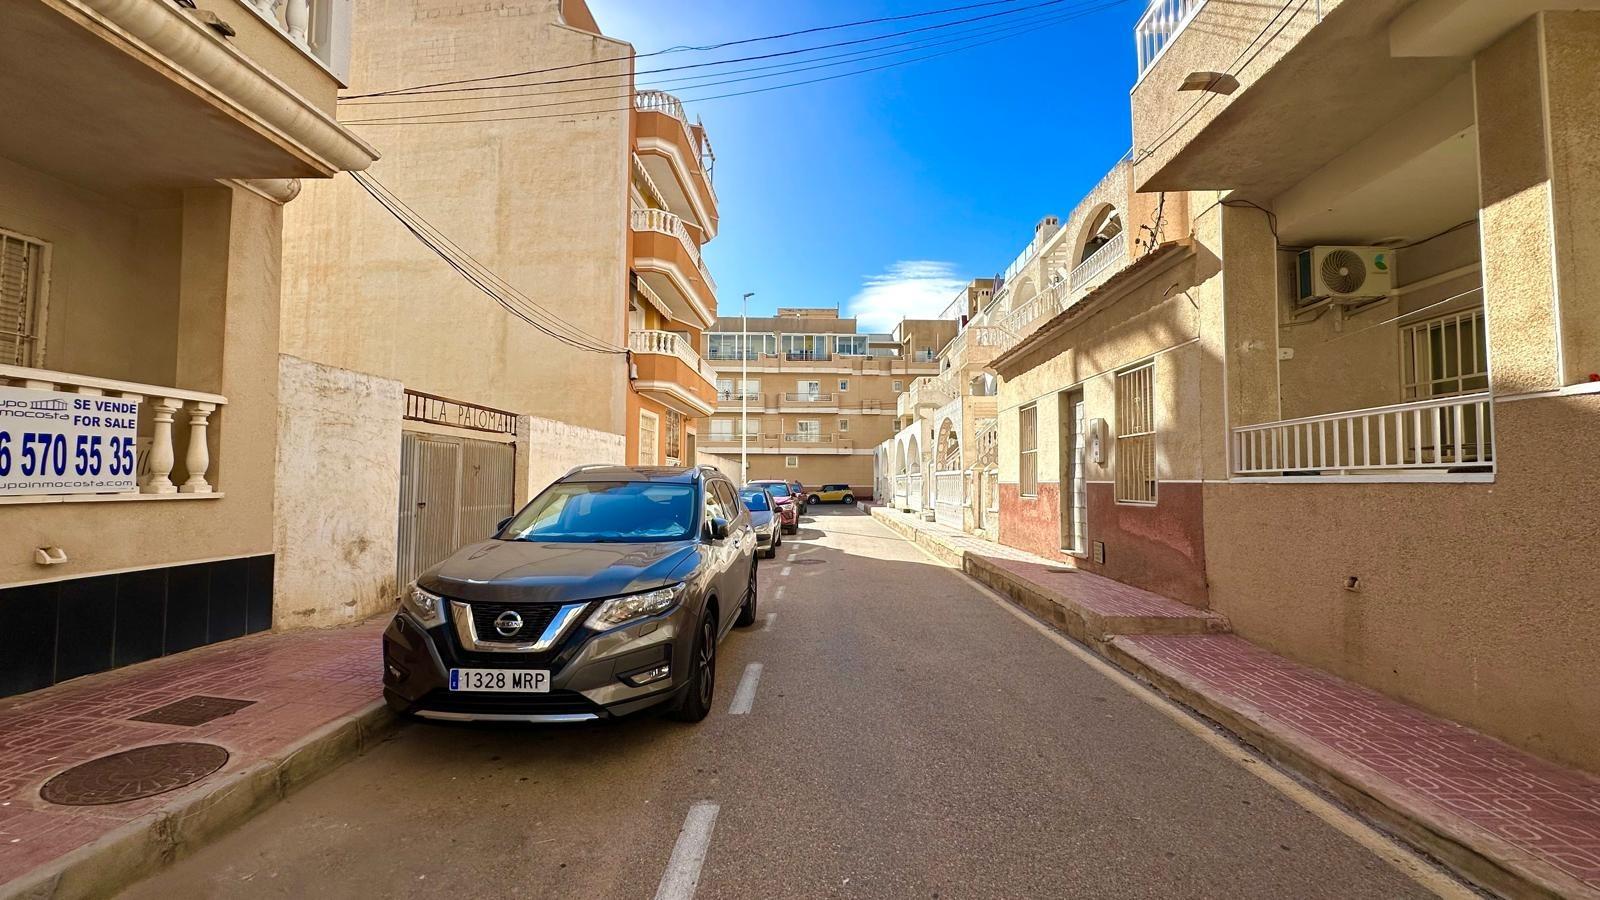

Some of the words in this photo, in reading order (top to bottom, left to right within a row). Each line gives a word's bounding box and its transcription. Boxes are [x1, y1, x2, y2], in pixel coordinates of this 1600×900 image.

[73, 399, 91, 410] SE
[96, 401, 137, 414] VENDE
[74, 415, 101, 427] FOR
[104, 418, 135, 429] SALE
[431, 400, 447, 422] LA
[458, 404, 503, 432] PALOMA
[0, 431, 11, 477] 6
[21, 432, 67, 477] 570
[75, 435, 102, 476] 55
[109, 436, 133, 476] 35
[464, 672, 506, 689] 1328
[512, 672, 545, 689] MRP
